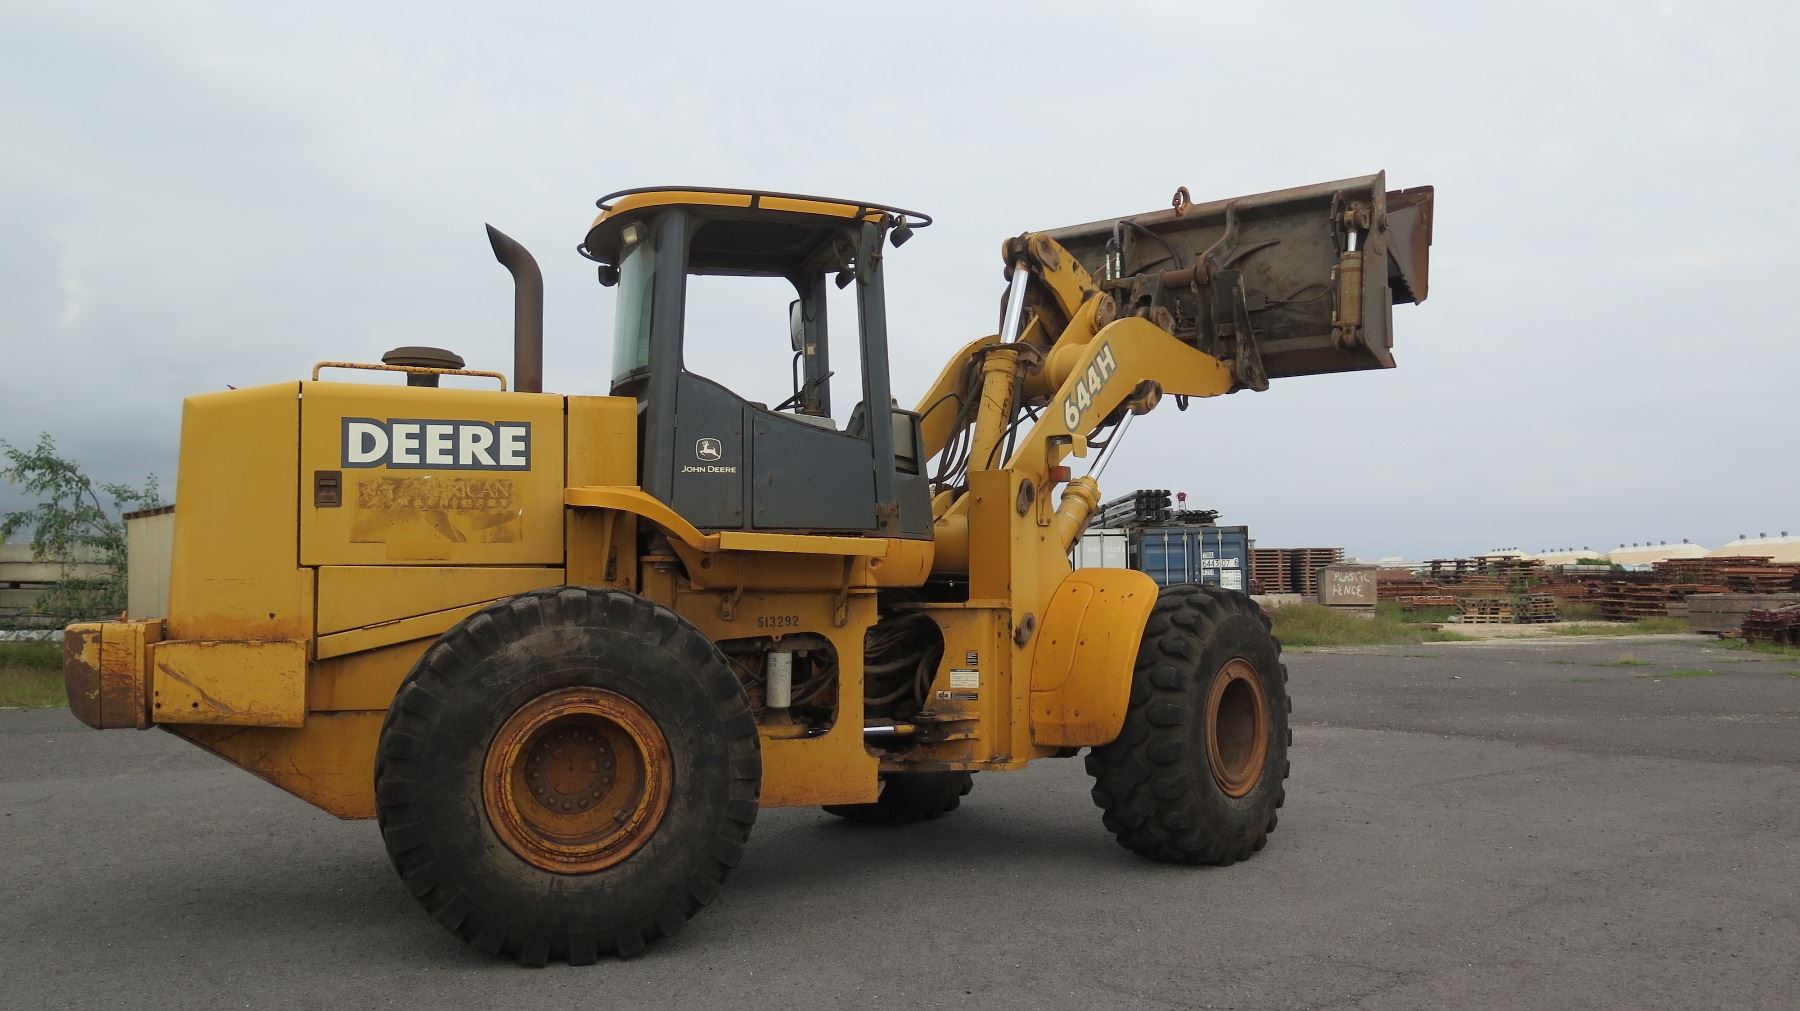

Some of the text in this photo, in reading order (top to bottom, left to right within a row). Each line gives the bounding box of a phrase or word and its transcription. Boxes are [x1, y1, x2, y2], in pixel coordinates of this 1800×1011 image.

[1065, 344, 1116, 429] 644H
[346, 421, 528, 467] DEERE
[681, 465, 737, 474] JOHN DEERE
[1333, 571, 1370, 582] PLASTIC
[1332, 584, 1364, 597] FENCE
[757, 615, 800, 628] 513292
